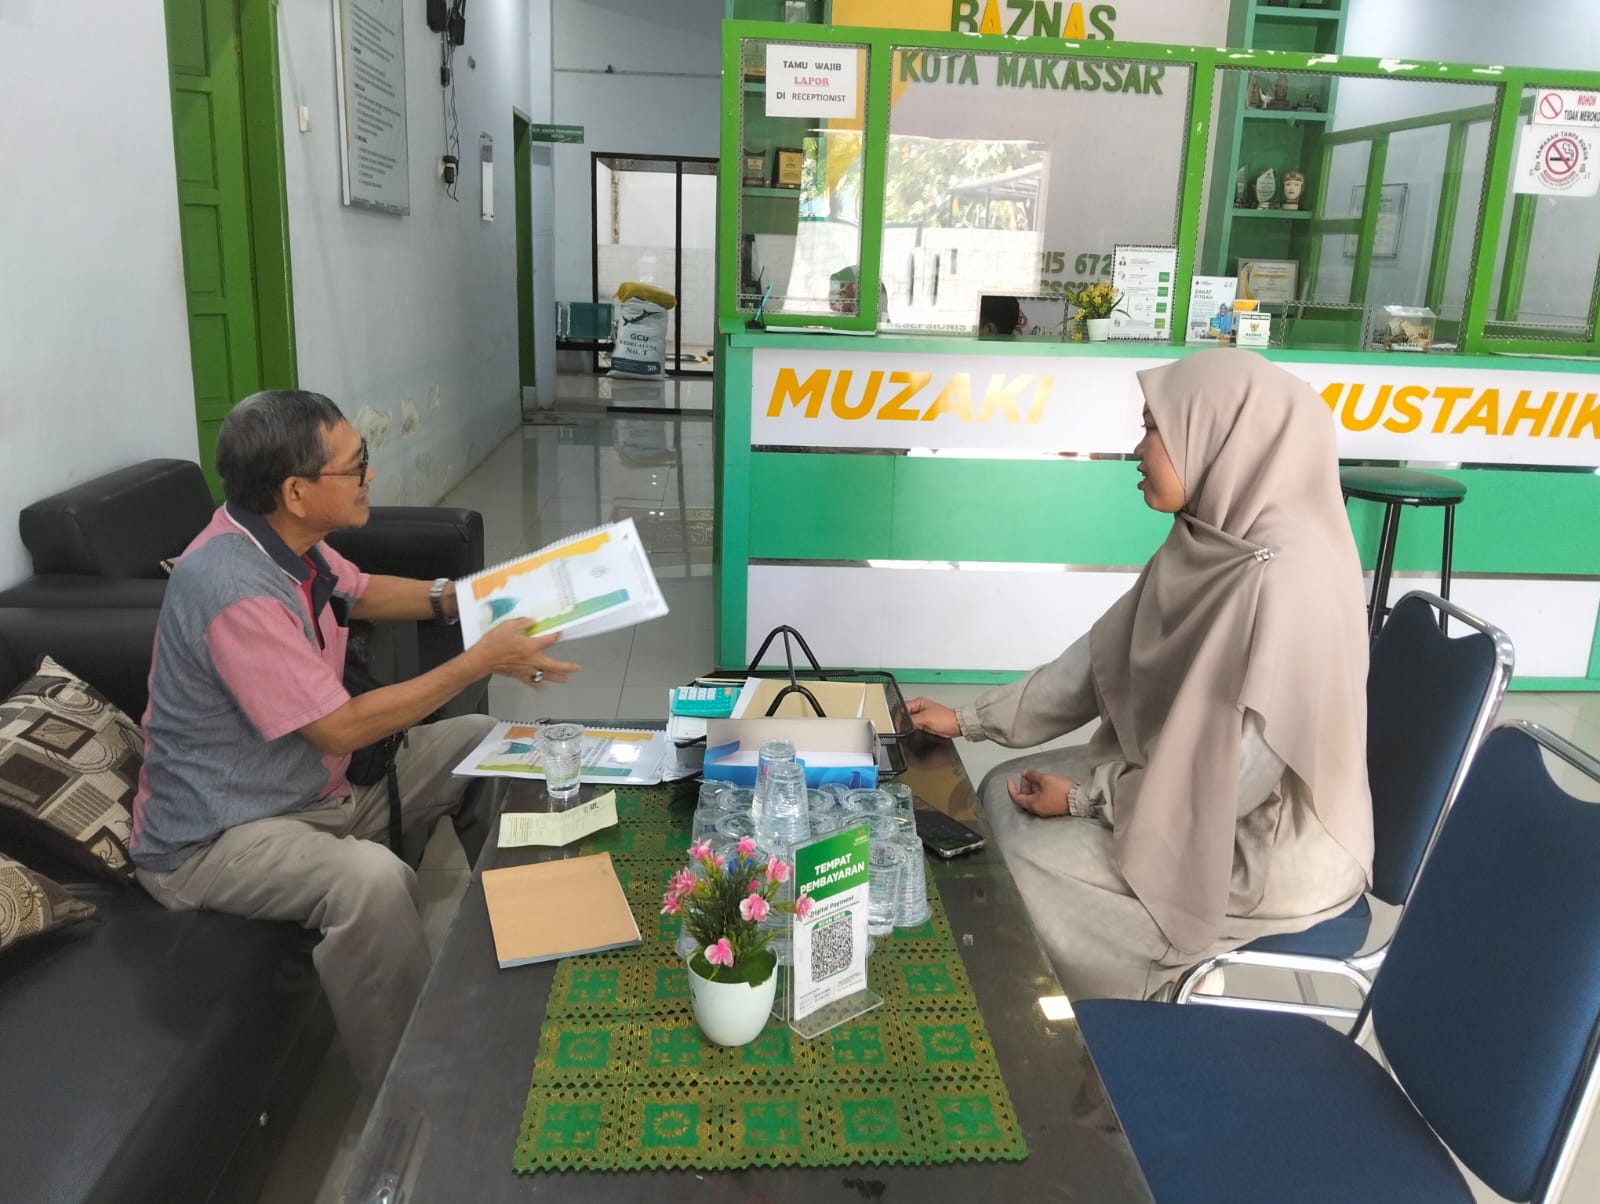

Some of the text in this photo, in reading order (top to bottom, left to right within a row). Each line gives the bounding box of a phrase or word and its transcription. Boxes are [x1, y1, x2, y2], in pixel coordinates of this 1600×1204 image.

[950, 0, 1117, 41] BAZNAS
[783, 60, 842, 71] TAMU WAJIB
[900, 51, 1166, 95] KOTA MAKASSAR
[793, 76, 830, 87] LAPOR
[776, 91, 846, 103] DI RECEPTIONIST
[1564, 109, 1579, 121] TIDAK
[1561, 131, 1580, 141] TANPA
[766, 368, 1056, 424] MUZAKI
[814, 853, 852, 875] TEMPAT
[800, 861, 865, 894] PEMBAYARAN
[810, 895, 854, 917] Digital Payment
